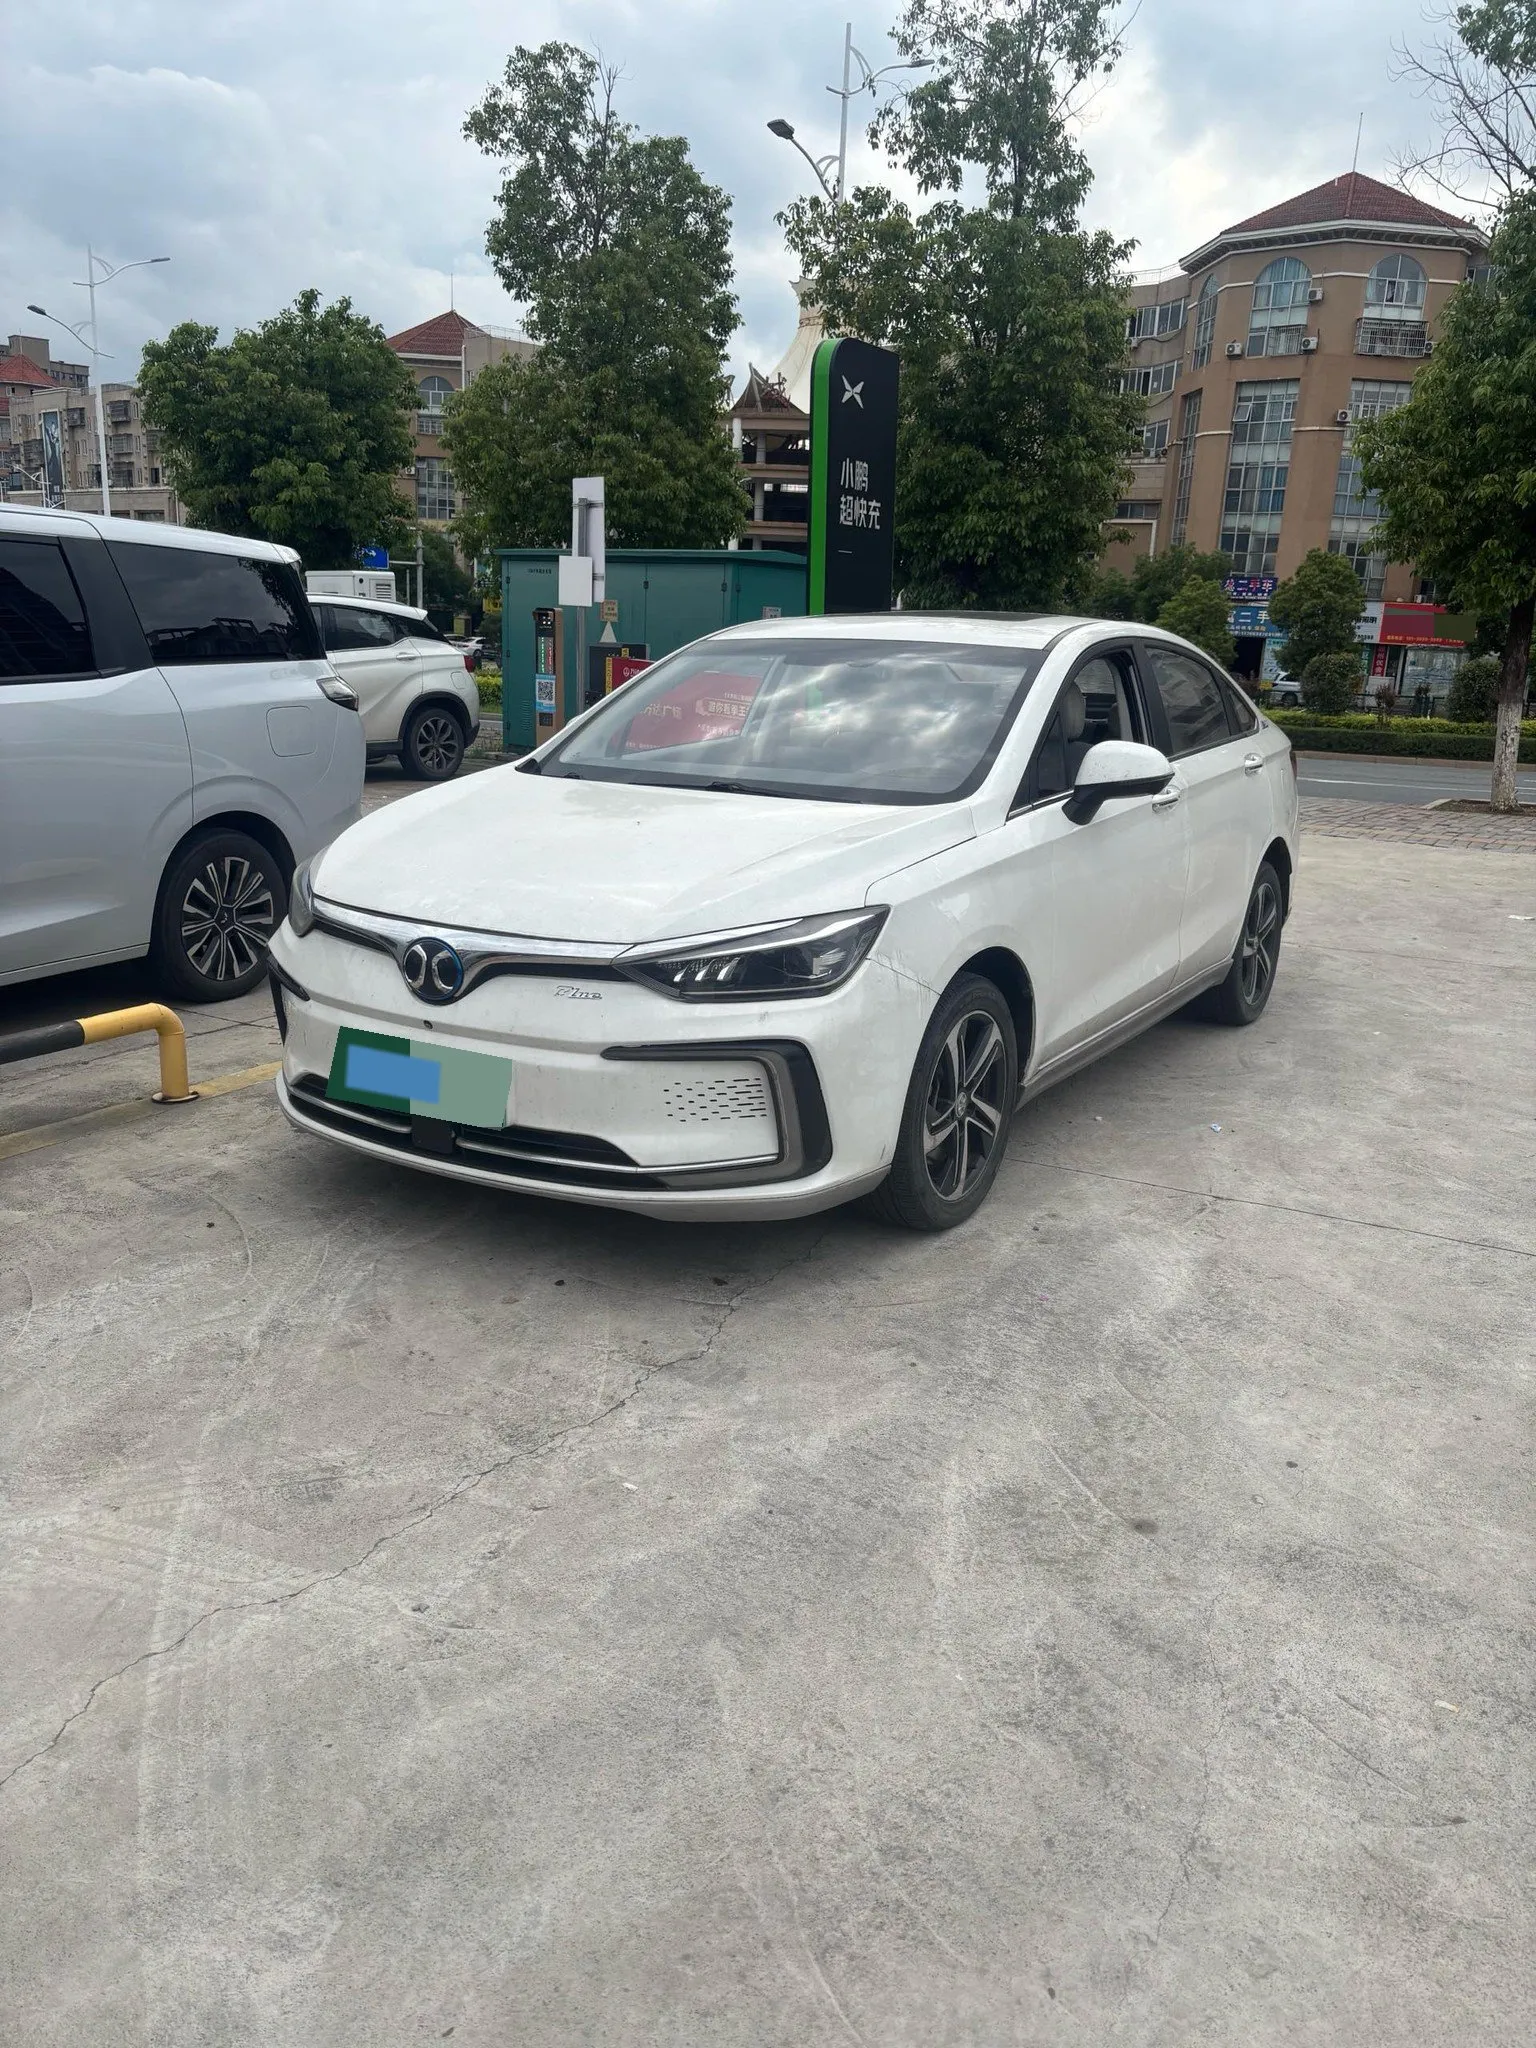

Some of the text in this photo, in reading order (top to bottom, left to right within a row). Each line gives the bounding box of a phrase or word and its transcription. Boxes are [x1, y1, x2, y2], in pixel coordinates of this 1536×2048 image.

[840, 458, 869, 493] 小鹏
[838, 495, 881, 530] 超快充
